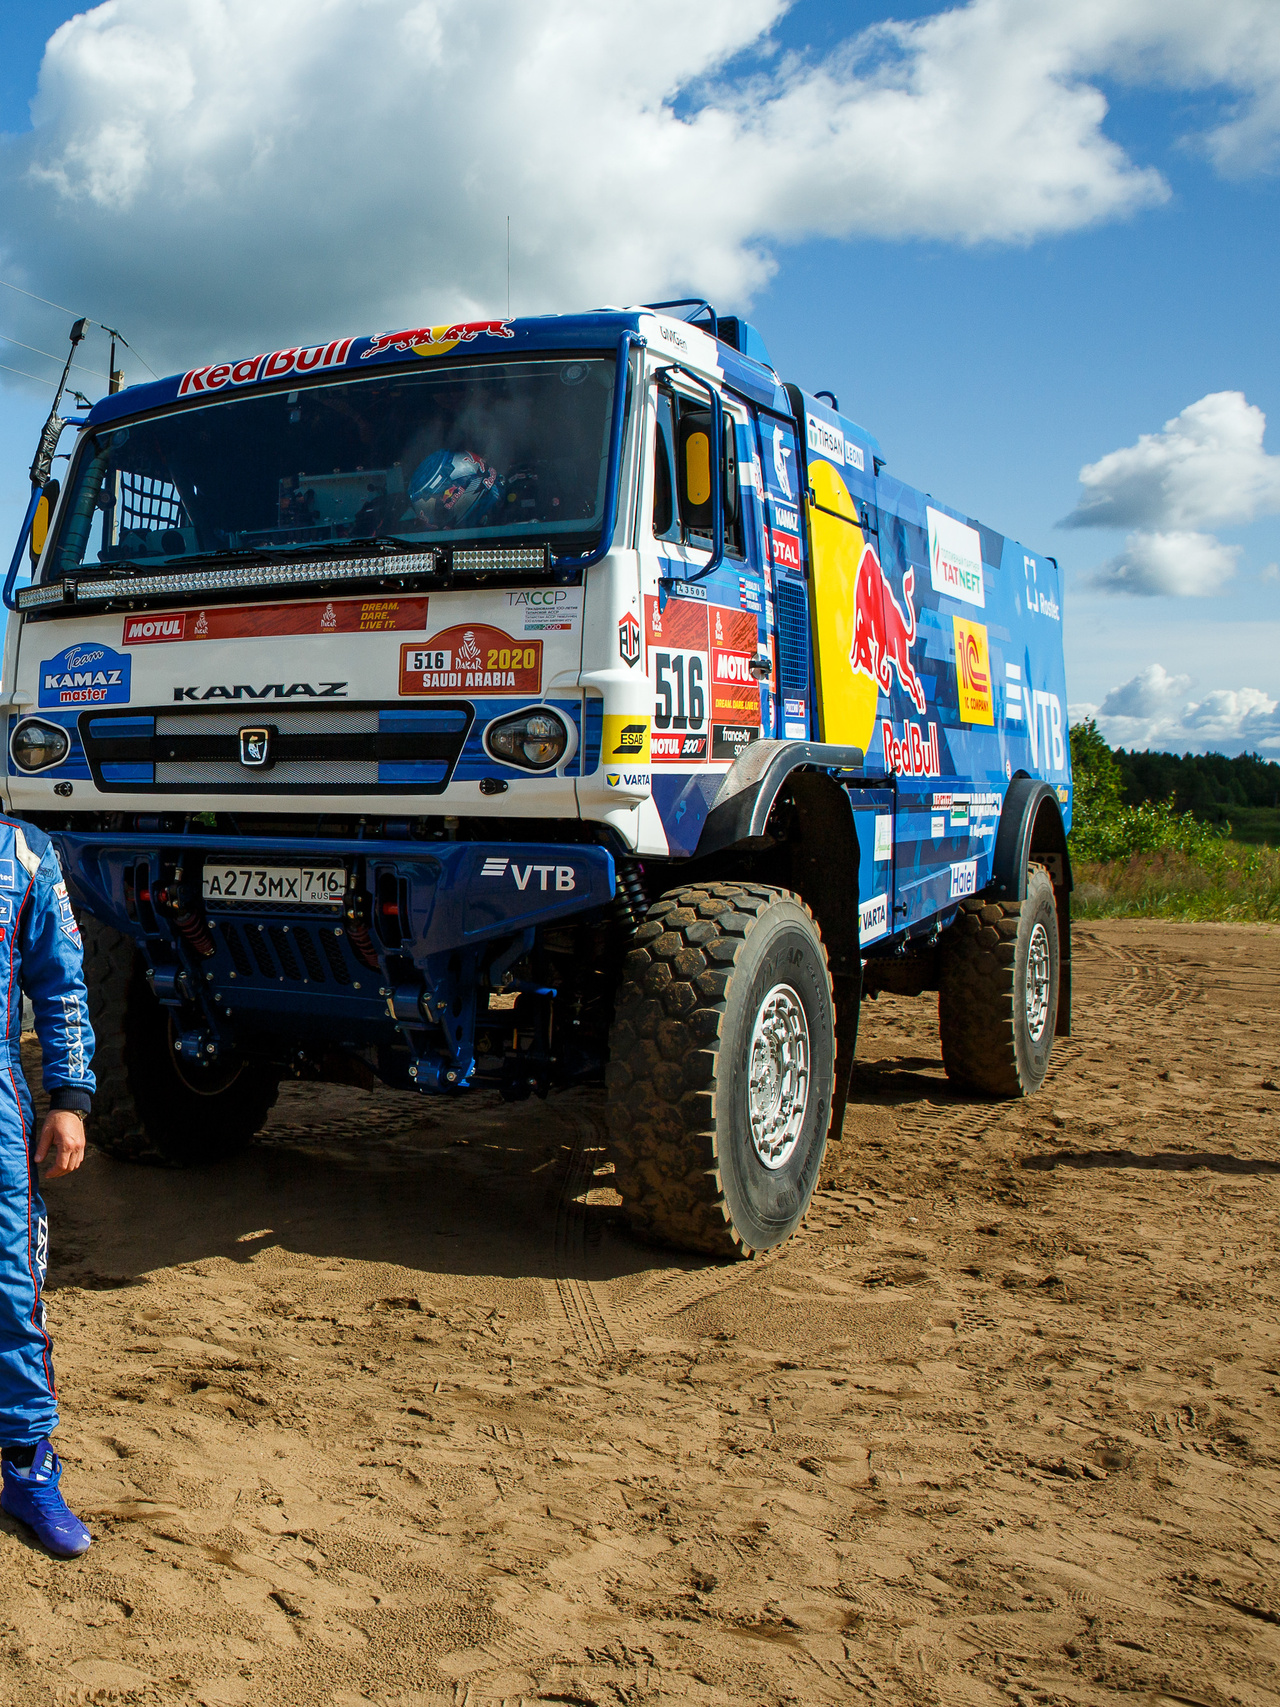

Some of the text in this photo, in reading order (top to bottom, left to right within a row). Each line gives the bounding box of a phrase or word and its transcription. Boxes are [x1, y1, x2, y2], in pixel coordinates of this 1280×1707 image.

[178, 336, 359, 397] Red Bull
[775, 506, 799, 532] KAMAZ
[942, 562, 980, 594] TATNEFT
[360, 611, 389, 620] DARE.
[361, 602, 399, 611] DREAM.
[1040, 592, 1060, 621] Rostec
[128, 620, 181, 638] MOTUL
[360, 620, 396, 629] LIVE IT.
[65, 647, 104, 671] Team
[414, 652, 444, 669] 516
[487, 648, 536, 670] 2020
[44, 670, 122, 689] KAMAZ
[423, 672, 516, 687] SAUDI ARABIA
[60, 688, 107, 702] master
[173, 682, 348, 702] KAMAZ
[655, 653, 704, 730] 516
[970, 698, 989, 712] COMPANY
[620, 733, 644, 745] ESAB
[1023, 687, 1064, 771] VTB
[651, 738, 706, 755] MOTUL 300V
[882, 720, 940, 777] Red Bull
[623, 774, 650, 785] VARTA
[304, 870, 338, 891] 716
[511, 864, 576, 892] VTB
[952, 865, 975, 896] Haier
[311, 892, 329, 900] RUS
[862, 905, 886, 930] VARTA
